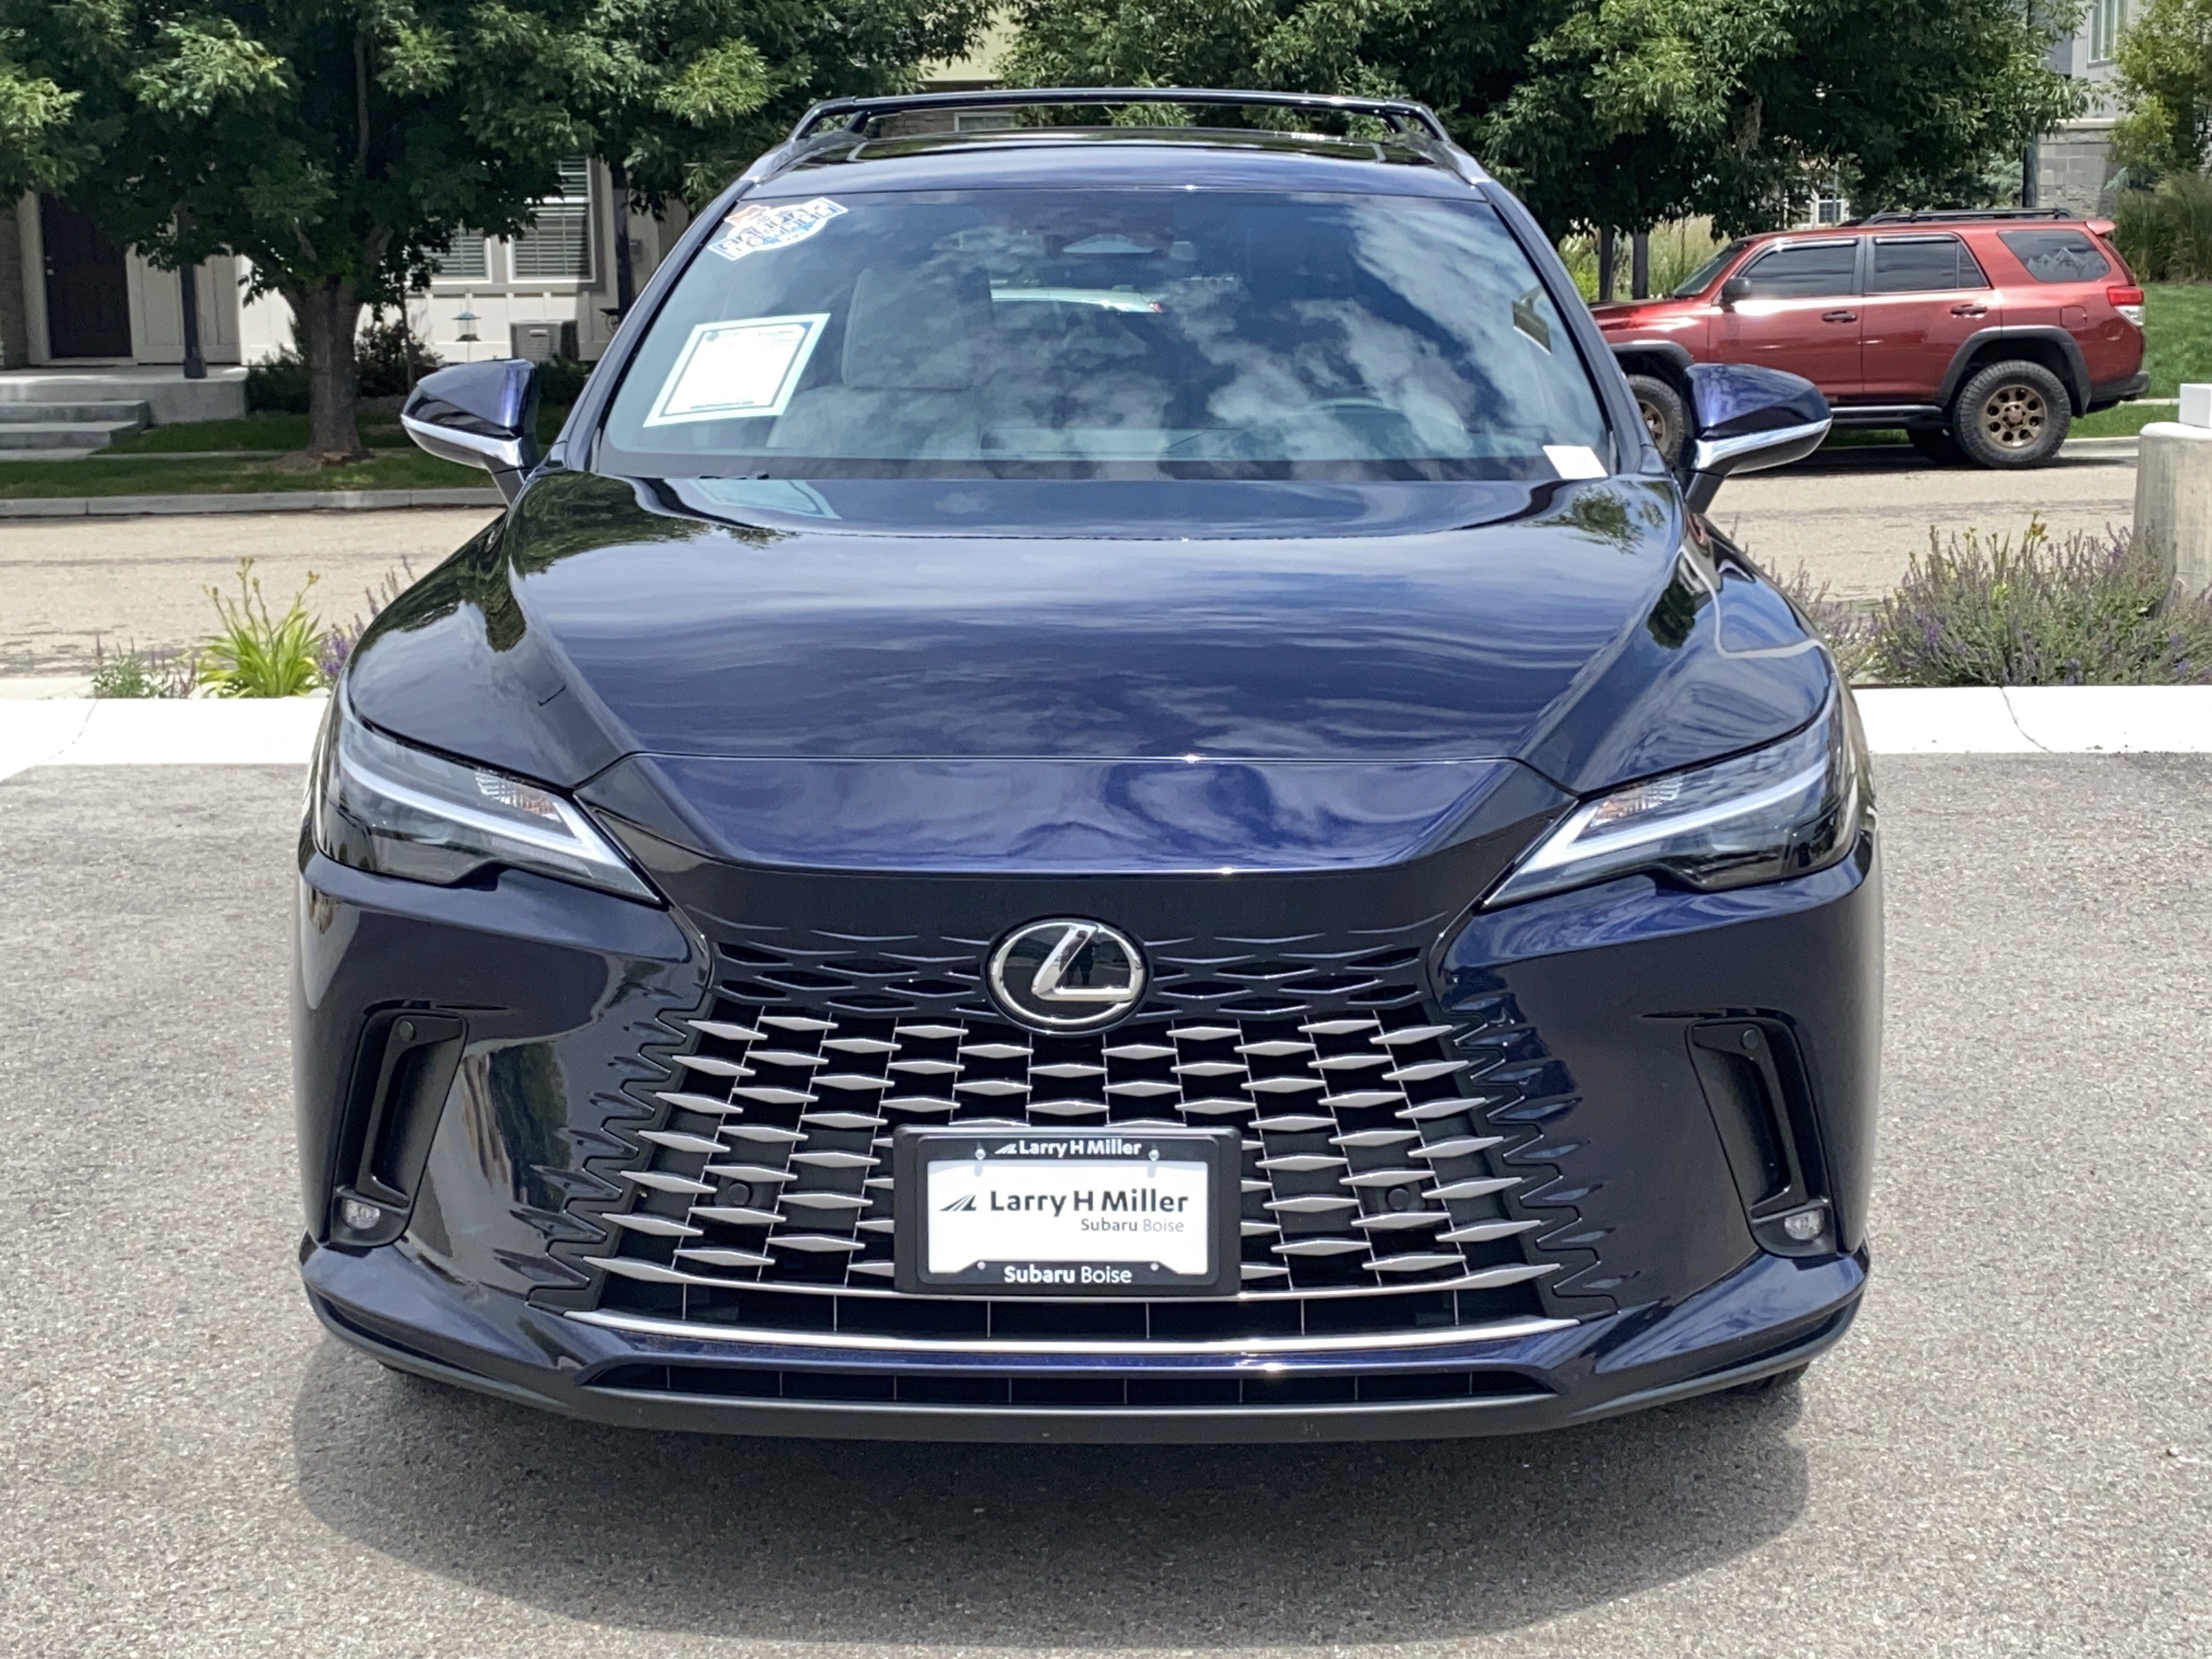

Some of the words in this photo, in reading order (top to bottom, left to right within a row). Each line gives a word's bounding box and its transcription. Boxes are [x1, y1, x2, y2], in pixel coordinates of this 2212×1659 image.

[1019, 1139, 1068, 1158] Larry
[1070, 1139, 1085, 1155] H
[1087, 1138, 1142, 1155] Miller
[990, 1190, 1067, 1217] Larry
[1074, 1190, 1093, 1212] H
[1101, 1188, 1189, 1212] Miller
[1081, 1217, 1138, 1232] Subaru
[1143, 1218, 1184, 1233] Boise
[1003, 1264, 1075, 1283] Subaru
[1081, 1265, 1132, 1284] Boise
